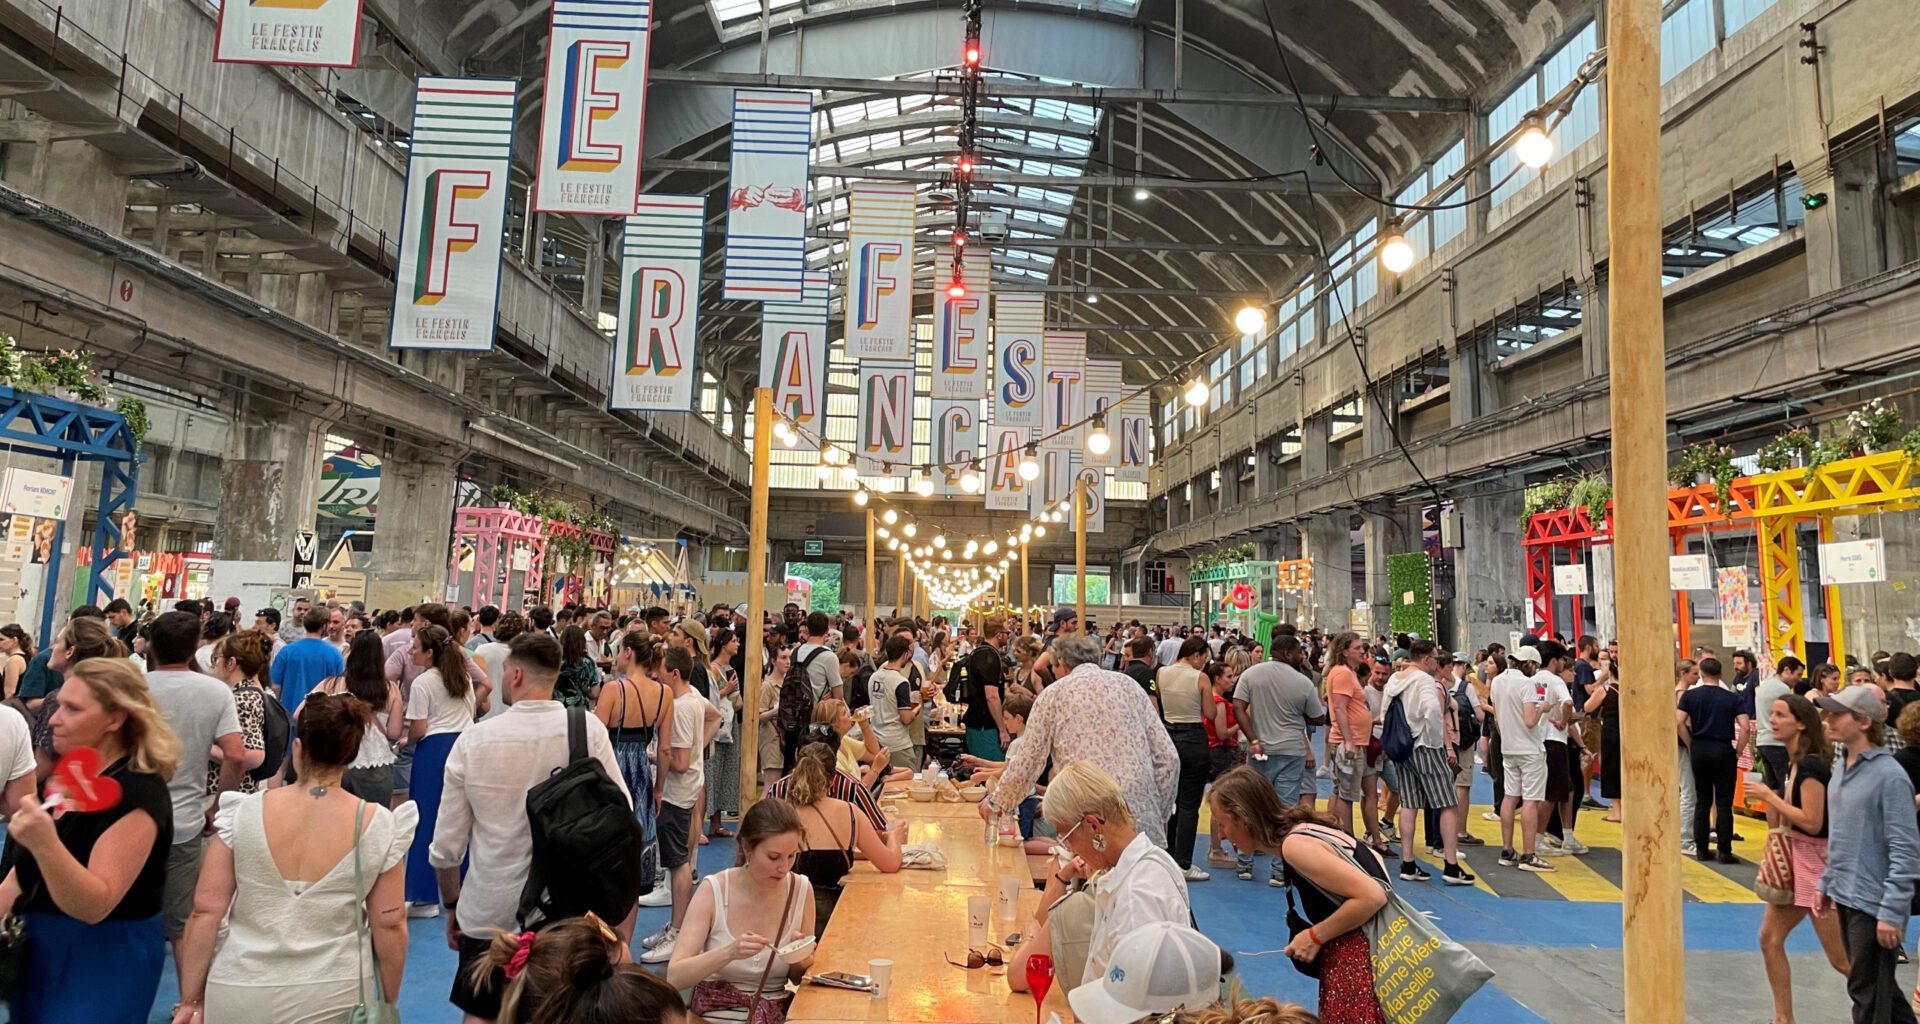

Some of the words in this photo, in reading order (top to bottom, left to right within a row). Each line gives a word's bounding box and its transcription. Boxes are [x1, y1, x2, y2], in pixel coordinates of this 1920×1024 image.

[252, 23, 269, 36] LE
[274, 24, 324, 39] FESTIN
[252, 37, 321, 53] FRANÇAIS
[557, 39, 630, 172] E
[560, 182, 572, 193] LE
[413, 169, 491, 306] F
[858, 242, 902, 330] F
[415, 318, 428, 329] LE
[625, 267, 685, 376] R
[942, 299, 979, 374] E
[771, 331, 815, 422] A
[1003, 339, 1035, 408] S
[1048, 371, 1080, 430] T
[865, 374, 907, 453] N
[1121, 418, 1145, 467] N
[991, 431, 1024, 492] A
[1044, 451, 1058, 505] I
[1076, 467, 1100, 518] S
[1403, 937, 1441, 969] Mère
[1382, 966, 1435, 1019] Marseille
